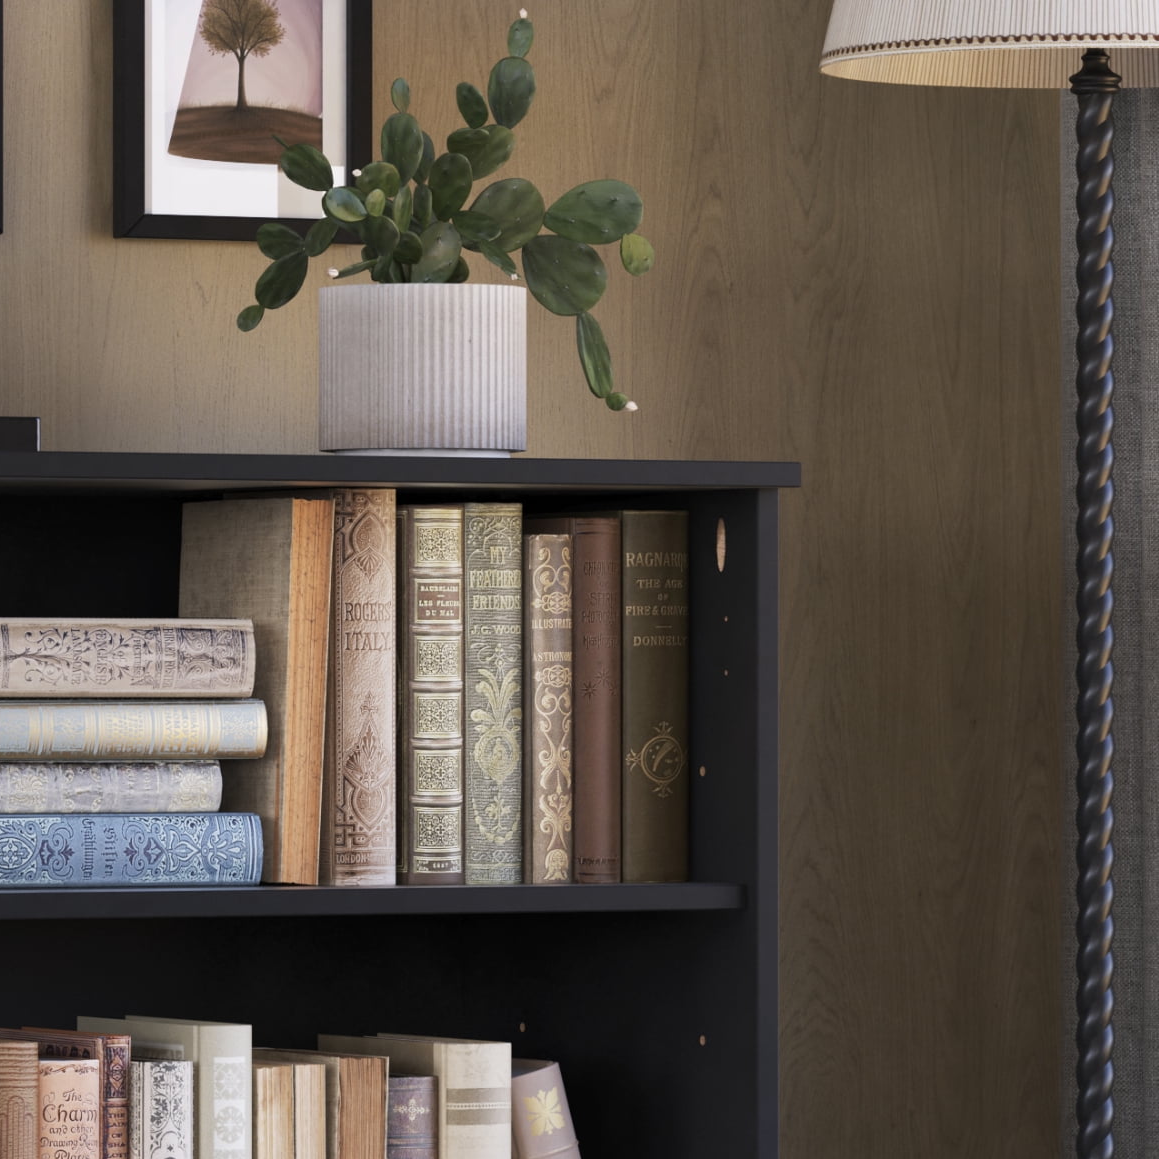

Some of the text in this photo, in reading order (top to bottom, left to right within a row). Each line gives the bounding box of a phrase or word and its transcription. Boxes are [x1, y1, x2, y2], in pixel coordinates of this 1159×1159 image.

[489, 546, 507, 565] MY
[636, 579, 661, 589] THE
[472, 594, 521, 610] FRIENDS
[439, 609, 455, 617] MAL
[625, 606, 651, 617] FIRE
[492, 624, 521, 635] WOOD
[62, 1088, 83, 1102] The
[42, 1104, 98, 1123] Charm
[49, 1125, 68, 1135] and
[40, 1136, 79, 1150] Drawing
